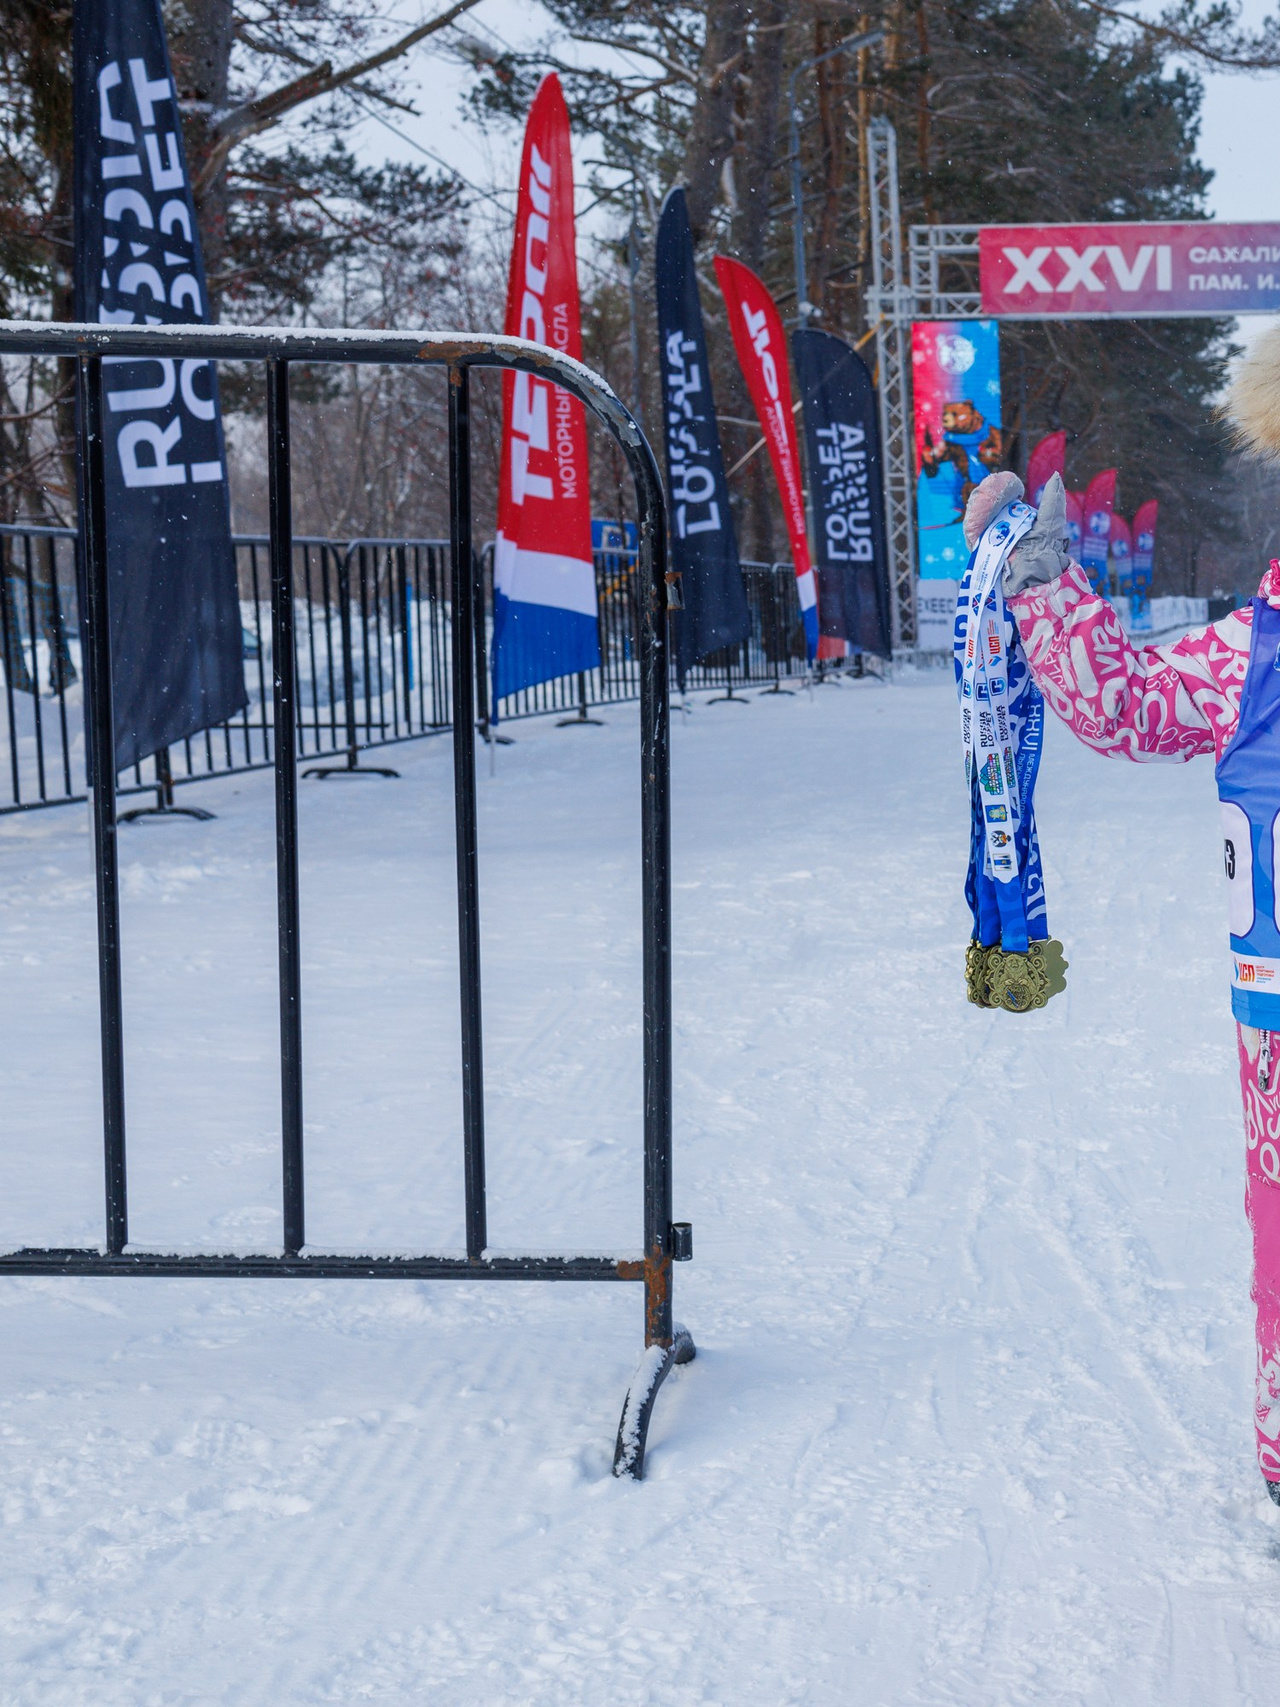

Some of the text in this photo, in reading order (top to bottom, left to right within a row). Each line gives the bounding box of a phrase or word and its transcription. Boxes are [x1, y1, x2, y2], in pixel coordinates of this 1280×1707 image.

[1001, 245, 1172, 293] XXVI
[1189, 271, 1250, 291] ПАМ.
[988, 636, 1001, 655] ЦСП
[979, 711, 989, 747] RUSSIA
[1021, 704, 1041, 751] XXVI
[1239, 963, 1255, 982] ЦСП
